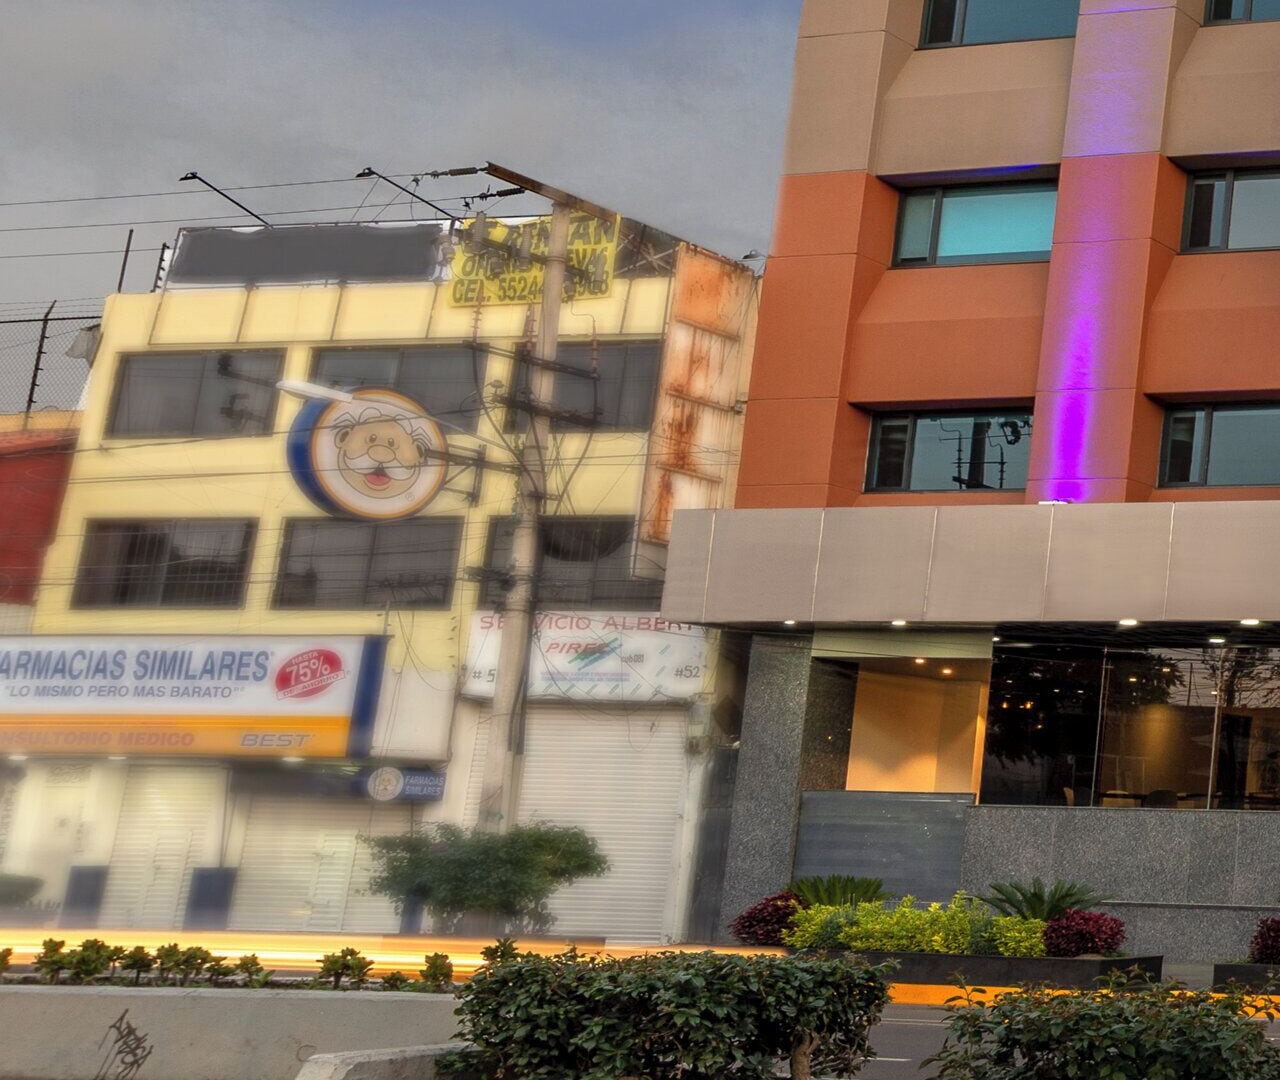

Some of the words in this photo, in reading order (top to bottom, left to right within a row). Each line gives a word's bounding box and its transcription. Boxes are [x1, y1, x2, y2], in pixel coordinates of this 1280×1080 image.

[480, 615, 592, 631] SEVICIO
[133, 650, 270, 682] SIMILARES
[286, 656, 331, 686] 75%
[674, 665, 700, 679] #52
[34, 685, 83, 697] MISMO
[87, 685, 129, 697] PERO
[132, 686, 166, 697] MAS
[240, 733, 311, 747] BEST
